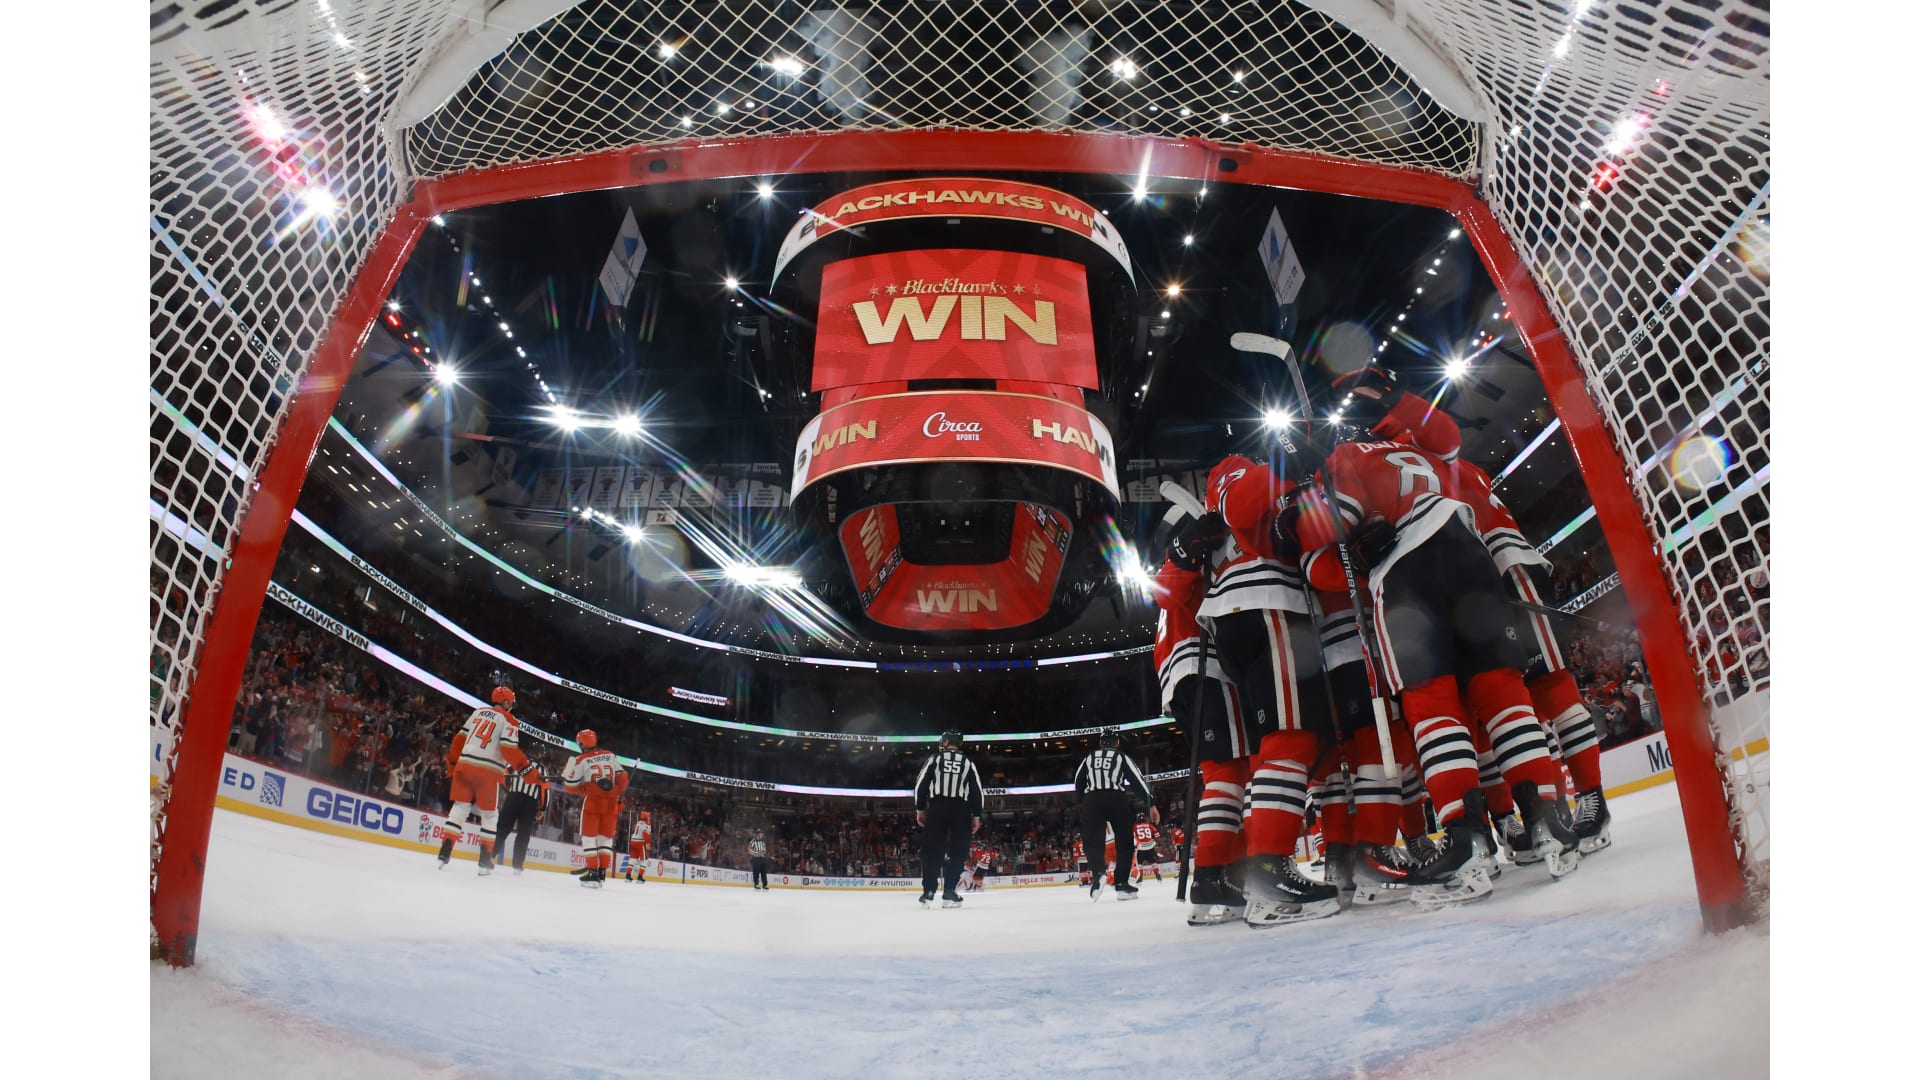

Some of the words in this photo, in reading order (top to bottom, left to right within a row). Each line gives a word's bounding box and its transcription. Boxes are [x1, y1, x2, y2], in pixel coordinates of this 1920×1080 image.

[1049, 200, 1108, 240] WIN
[853, 295, 1058, 345] WIN
[813, 420, 877, 456] WIN
[922, 411, 983, 438] Circa
[956, 433, 980, 441] SPORTS
[350, 555, 411, 603] BLACKHAWKS
[410, 597, 427, 613] WIN
[917, 588, 998, 613] WIN
[267, 583, 344, 637] ACKHAWKS
[345, 627, 370, 650] WIN
[561, 679, 619, 703] BLACKHAWKS
[620, 699, 638, 708] WIN
[466, 718, 497, 750] 74
[547, 733, 565, 746] WIN
[943, 761, 961, 774] 55
[1094, 757, 1112, 770] 86
[686, 772, 753, 788] BLACKHAWKS
[755, 781, 776, 790] WIN
[985, 787, 1006, 795] WIN
[306, 787, 404, 835] GEICO
[1136, 827, 1152, 840] 59
